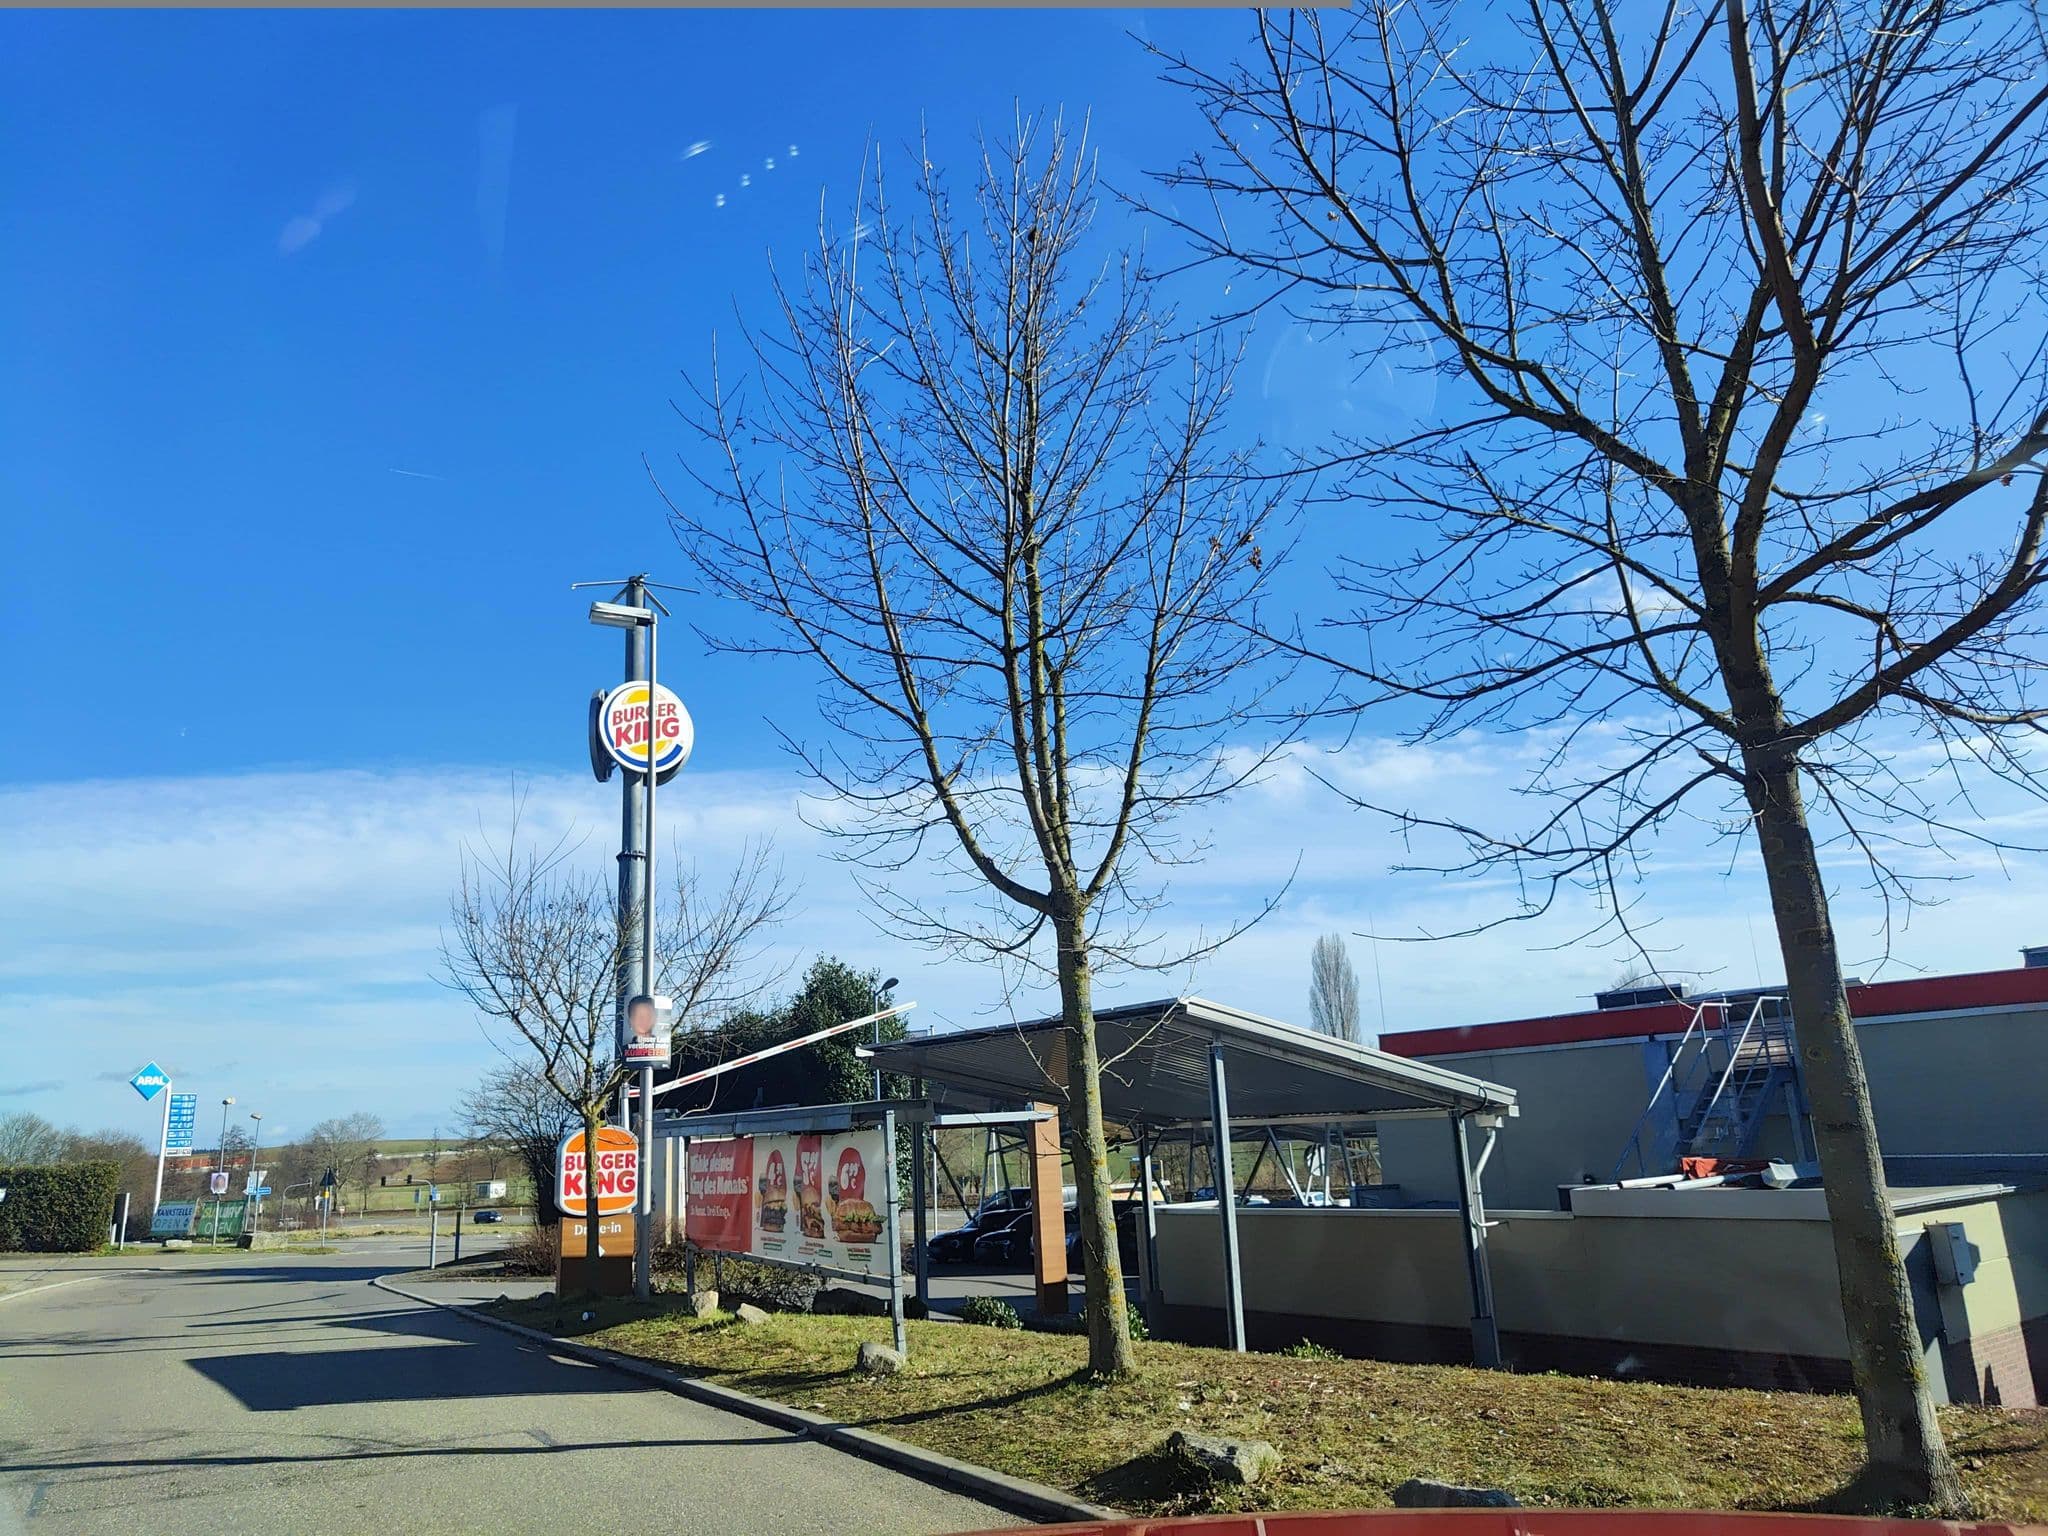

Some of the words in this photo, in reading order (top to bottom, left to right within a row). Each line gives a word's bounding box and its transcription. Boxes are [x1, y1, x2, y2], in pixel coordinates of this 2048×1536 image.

[136, 1075, 166, 1086] ARAL
[564, 1153, 637, 1172] BUGER
[563, 1170, 637, 1197] KNG
[203, 1206, 244, 1218] SUWAY
[574, 1221, 622, 1236] Dre-in
